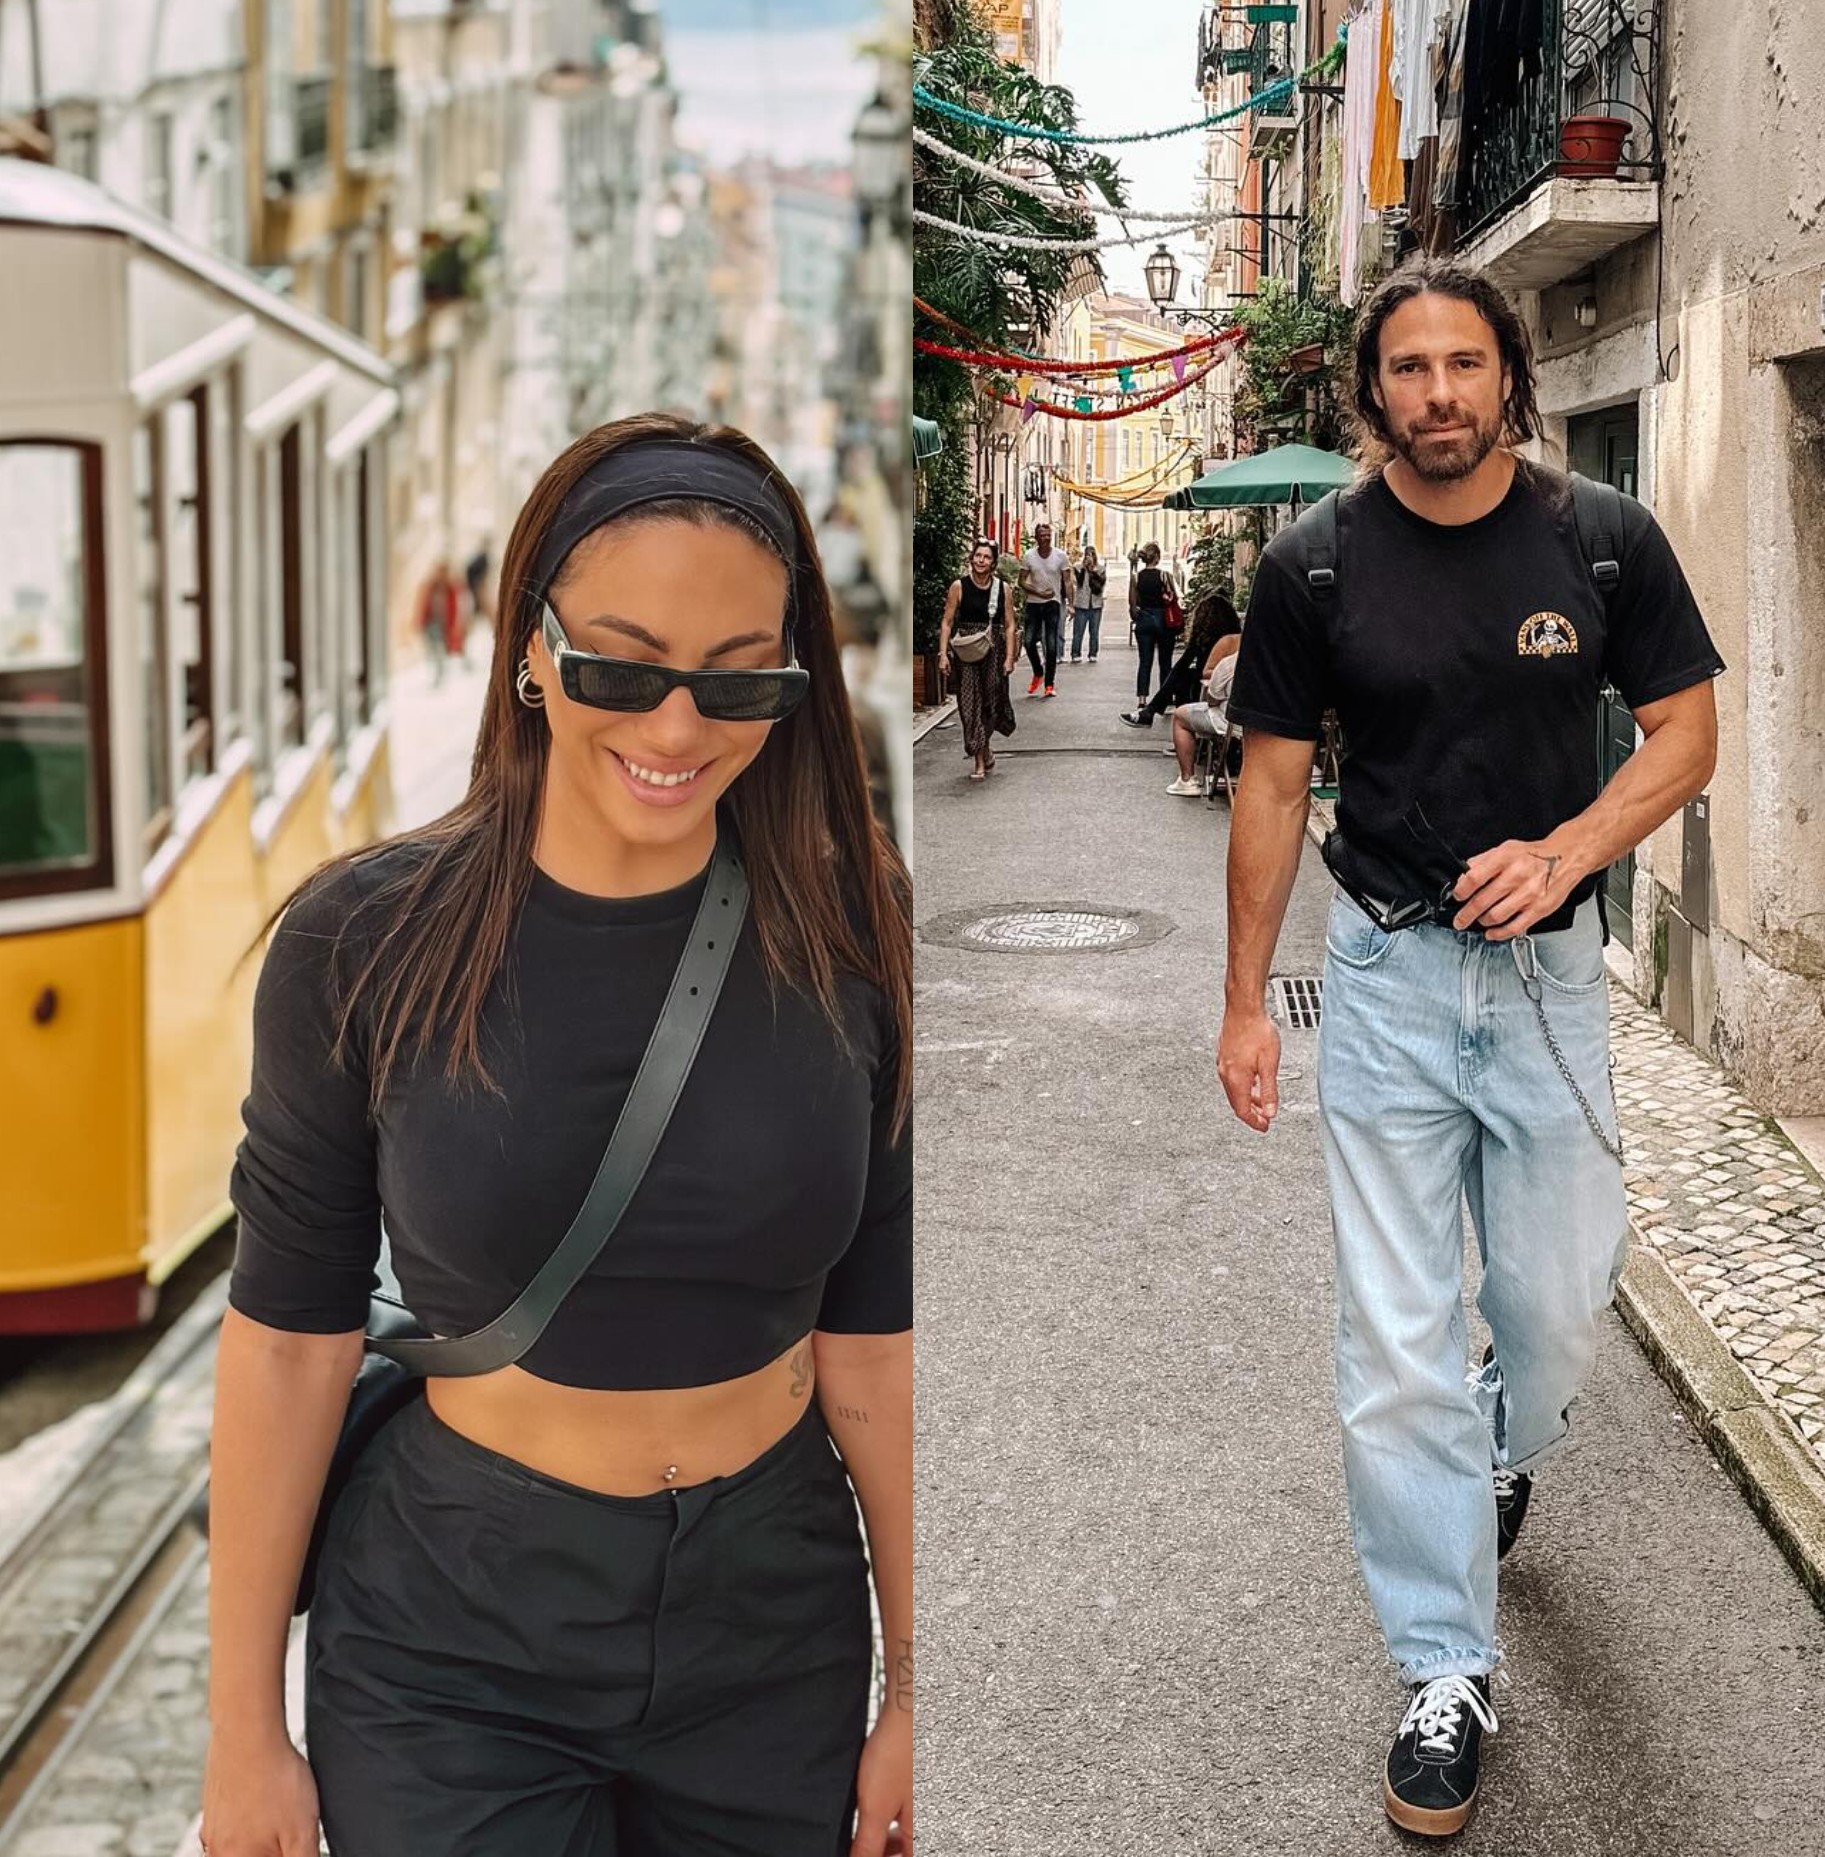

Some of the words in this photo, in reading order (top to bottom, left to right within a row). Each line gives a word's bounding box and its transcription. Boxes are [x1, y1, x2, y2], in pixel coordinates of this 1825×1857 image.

[1519, 623, 1530, 644] VANS
[1530, 613, 1543, 624] OFF
[1546, 613, 1561, 622] THE
[1562, 620, 1577, 642] WALL
